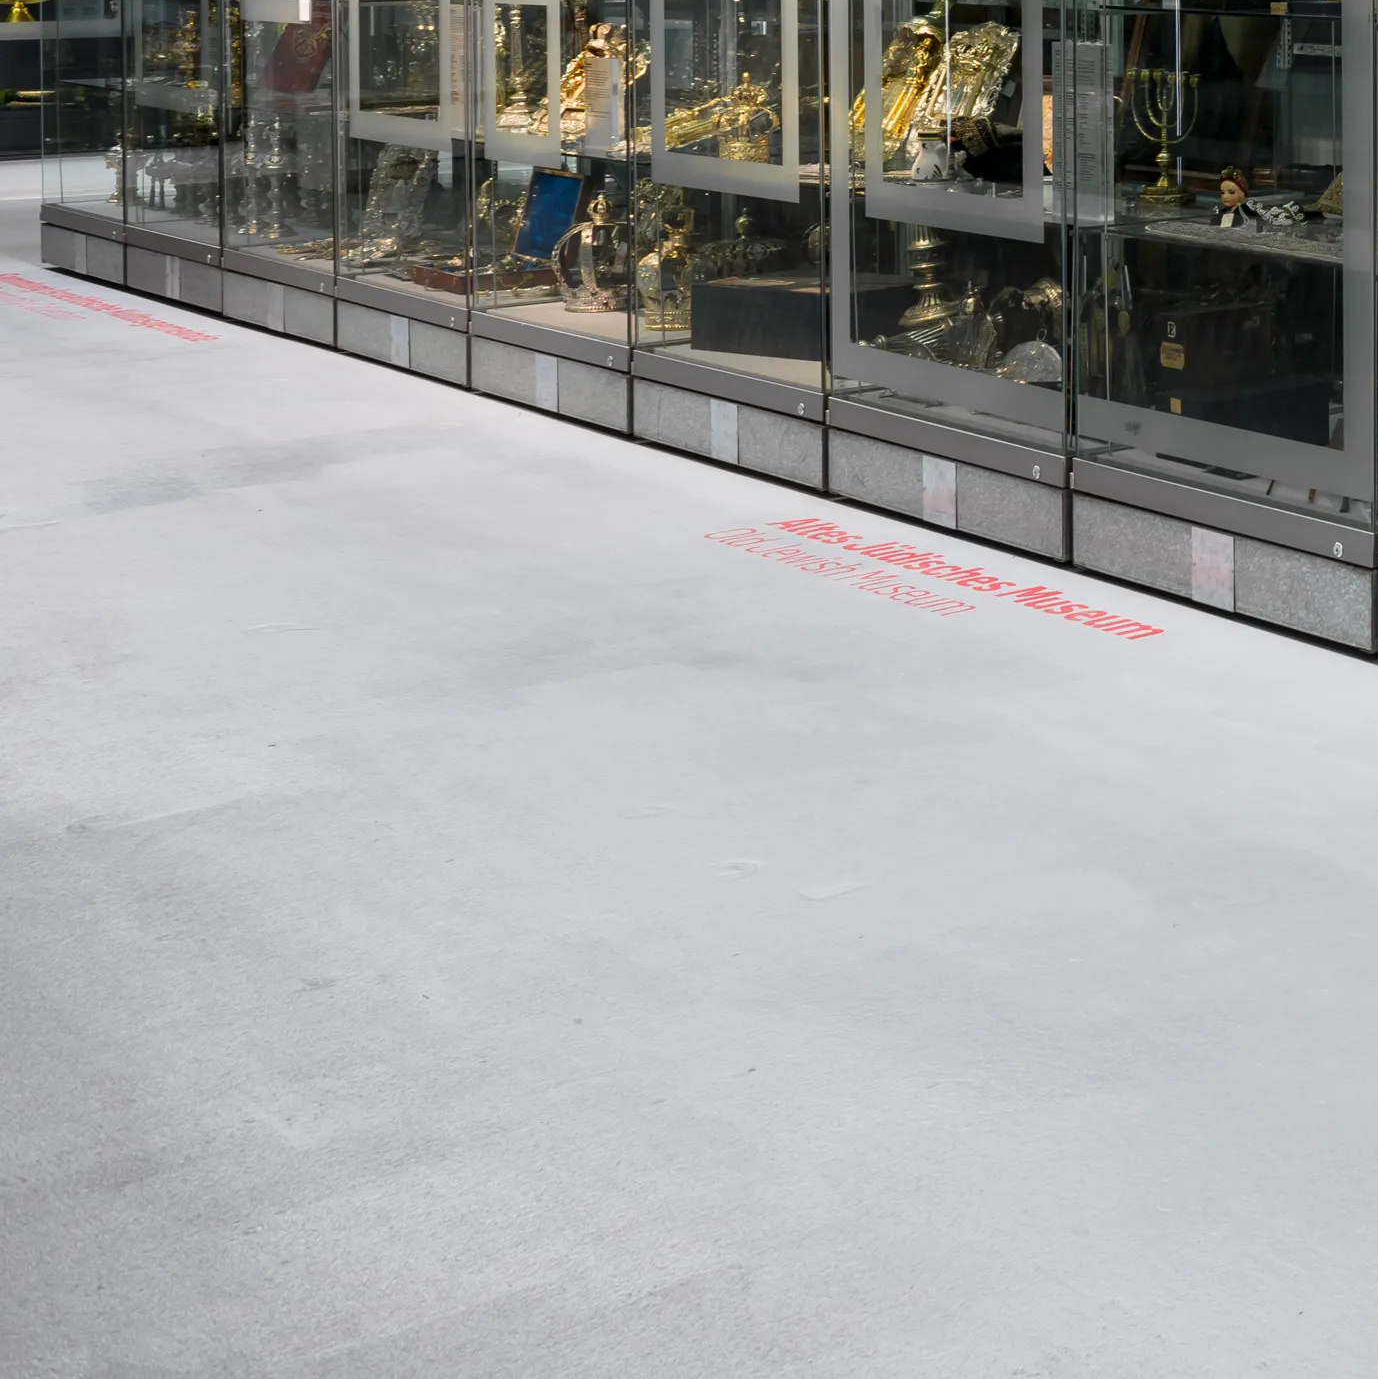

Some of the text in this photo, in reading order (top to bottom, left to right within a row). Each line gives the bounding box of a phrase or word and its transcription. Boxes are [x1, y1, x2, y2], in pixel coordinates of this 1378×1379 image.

[703, 528, 976, 617] Old Jewish Museum
[764, 517, 1166, 640] Altes Jüdisches Museum
